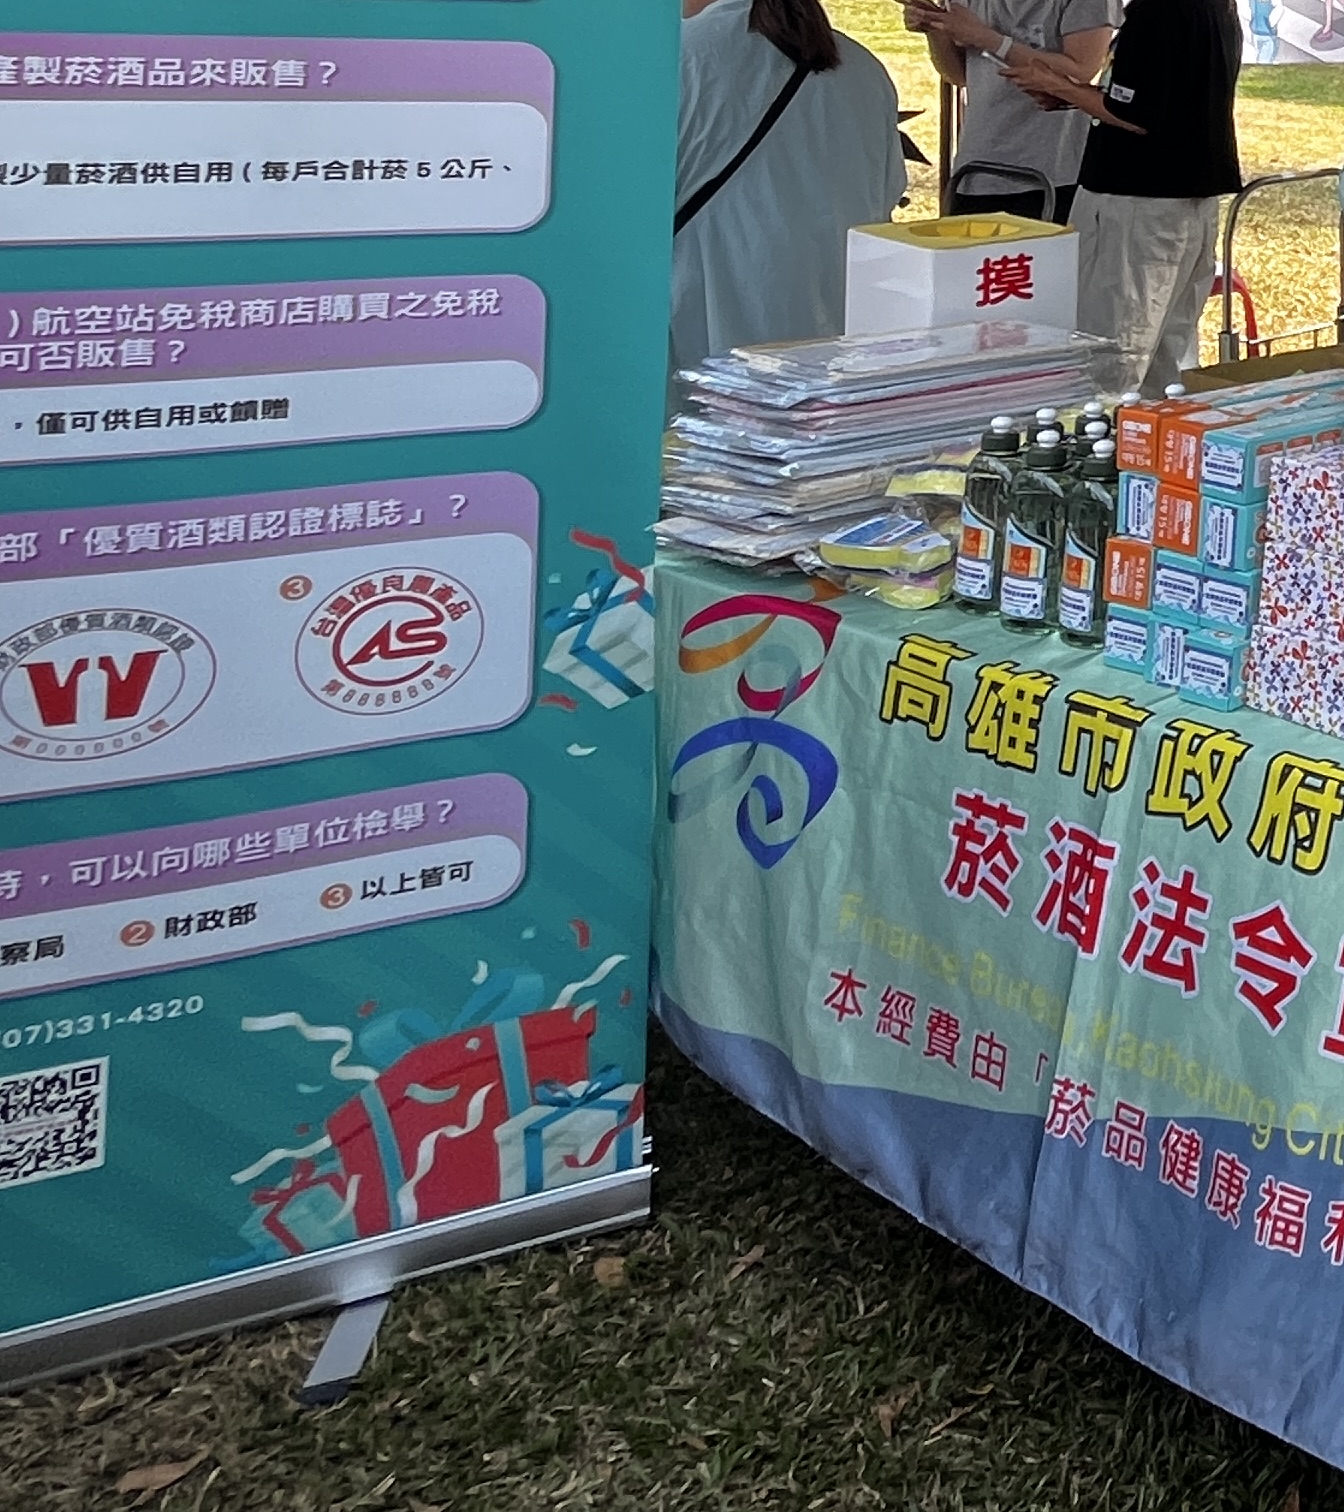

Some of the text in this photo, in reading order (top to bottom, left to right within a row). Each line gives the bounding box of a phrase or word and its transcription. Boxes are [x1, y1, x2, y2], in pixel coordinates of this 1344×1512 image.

[975, 254, 1034, 307] 摸
[165, 902, 258, 939] 財政部
[359, 860, 474, 900] 以上皆可
[835, 893, 962, 986] Finance
[1092, 1013, 1277, 1152] Kaohsiung
